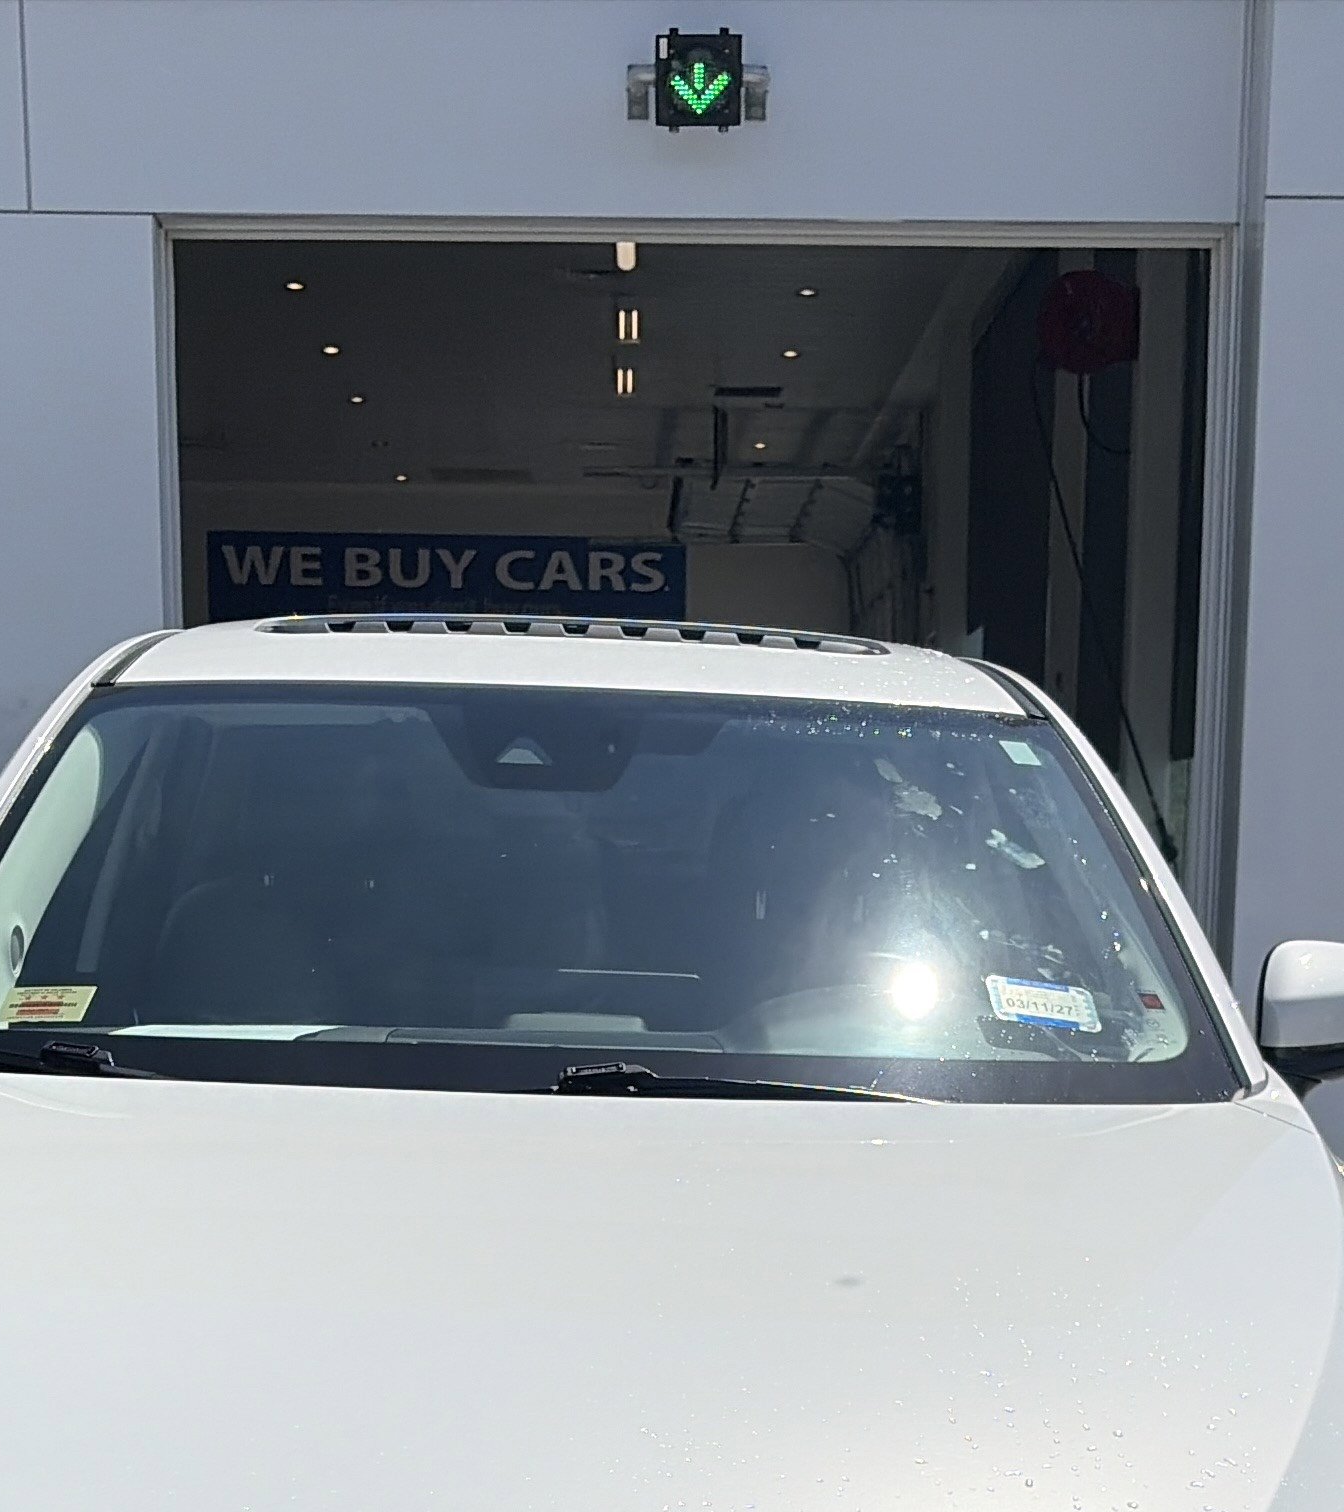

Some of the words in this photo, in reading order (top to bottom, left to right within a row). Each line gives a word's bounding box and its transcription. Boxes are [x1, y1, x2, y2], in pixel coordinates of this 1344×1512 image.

[221, 544, 324, 587] WE
[343, 546, 477, 590] BUY
[494, 549, 671, 593] CARS.
[1005, 996, 1073, 1016] 03/11/27
